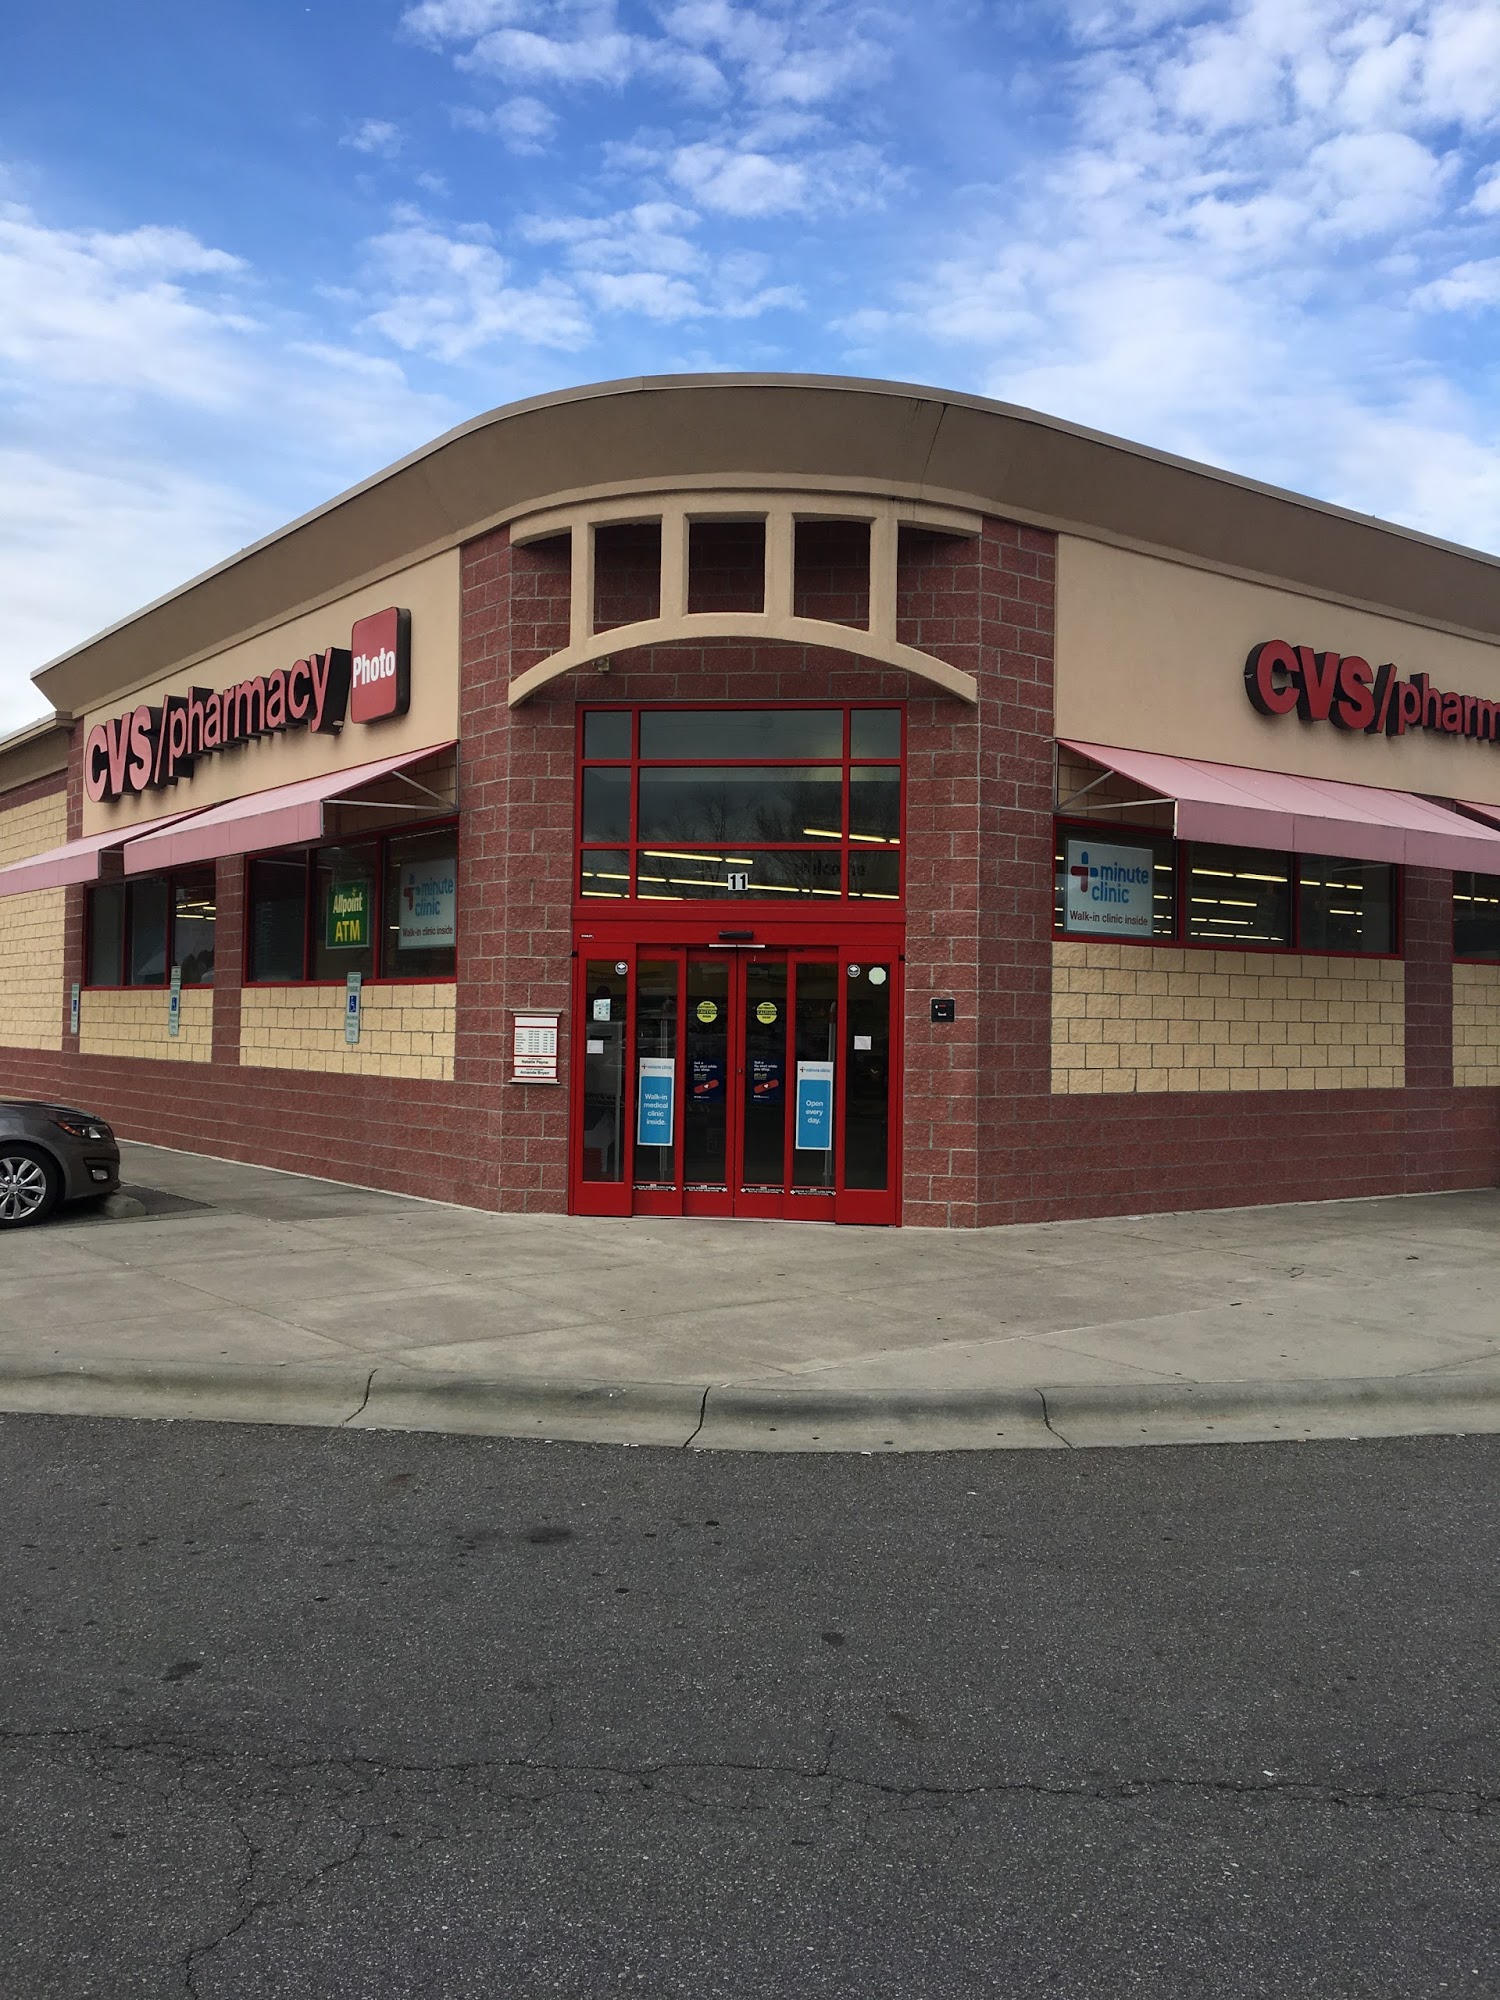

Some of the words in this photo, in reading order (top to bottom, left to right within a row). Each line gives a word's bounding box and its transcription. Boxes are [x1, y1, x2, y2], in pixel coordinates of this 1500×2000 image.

[352, 647, 396, 688] Photo
[85, 647, 338, 803] CVS/pharmacy
[730, 874, 746, 890] 11
[1101, 862, 1149, 884] minute
[421, 877, 454, 896] minute
[1091, 881, 1130, 903] clinic
[333, 892, 363, 917] Allpoint
[414, 897, 441, 917] clinic
[1069, 909, 1100, 923] Walk-in
[1101, 913, 1123, 924] clinic
[1124, 915, 1149, 926] inside
[335, 919, 361, 942] ATM
[402, 927, 421, 937] Walk-in
[422, 926, 436, 937] clinic
[437, 924, 453, 936] inside
[643, 1101, 669, 1109] medical
[805, 1099, 824, 1108] Open
[646, 1118, 667, 1126] inside.
[805, 1109, 824, 1117] every
[807, 1117, 821, 1125] day.
